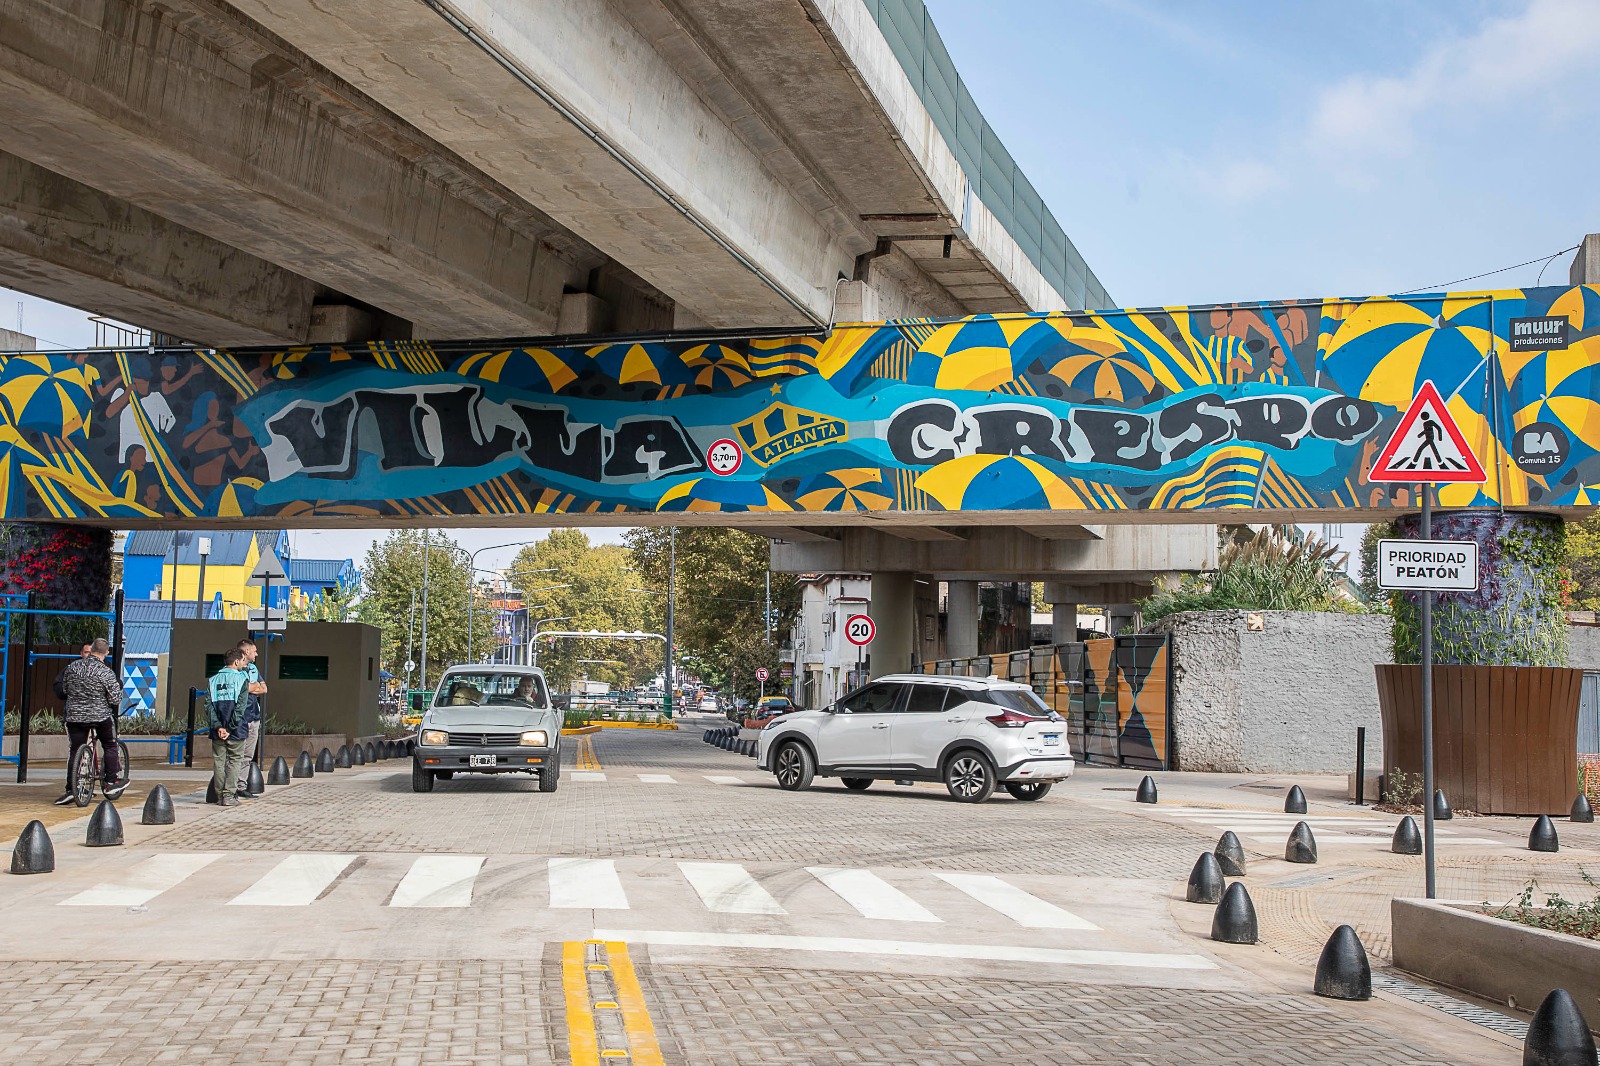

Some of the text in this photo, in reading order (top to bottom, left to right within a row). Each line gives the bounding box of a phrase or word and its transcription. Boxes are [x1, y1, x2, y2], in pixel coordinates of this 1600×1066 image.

[1514, 320, 1564, 336] muur
[1514, 337, 1563, 349] producciones
[884, 393, 1382, 470] CRESPO
[763, 423, 838, 460] ATLANTA
[1523, 431, 1560, 454] BA
[1518, 455, 1561, 464] Comuna 15
[1389, 551, 1467, 564] PRIORIDAD
[1396, 565, 1459, 578] PEATÓN
[851, 623, 869, 637] 20
